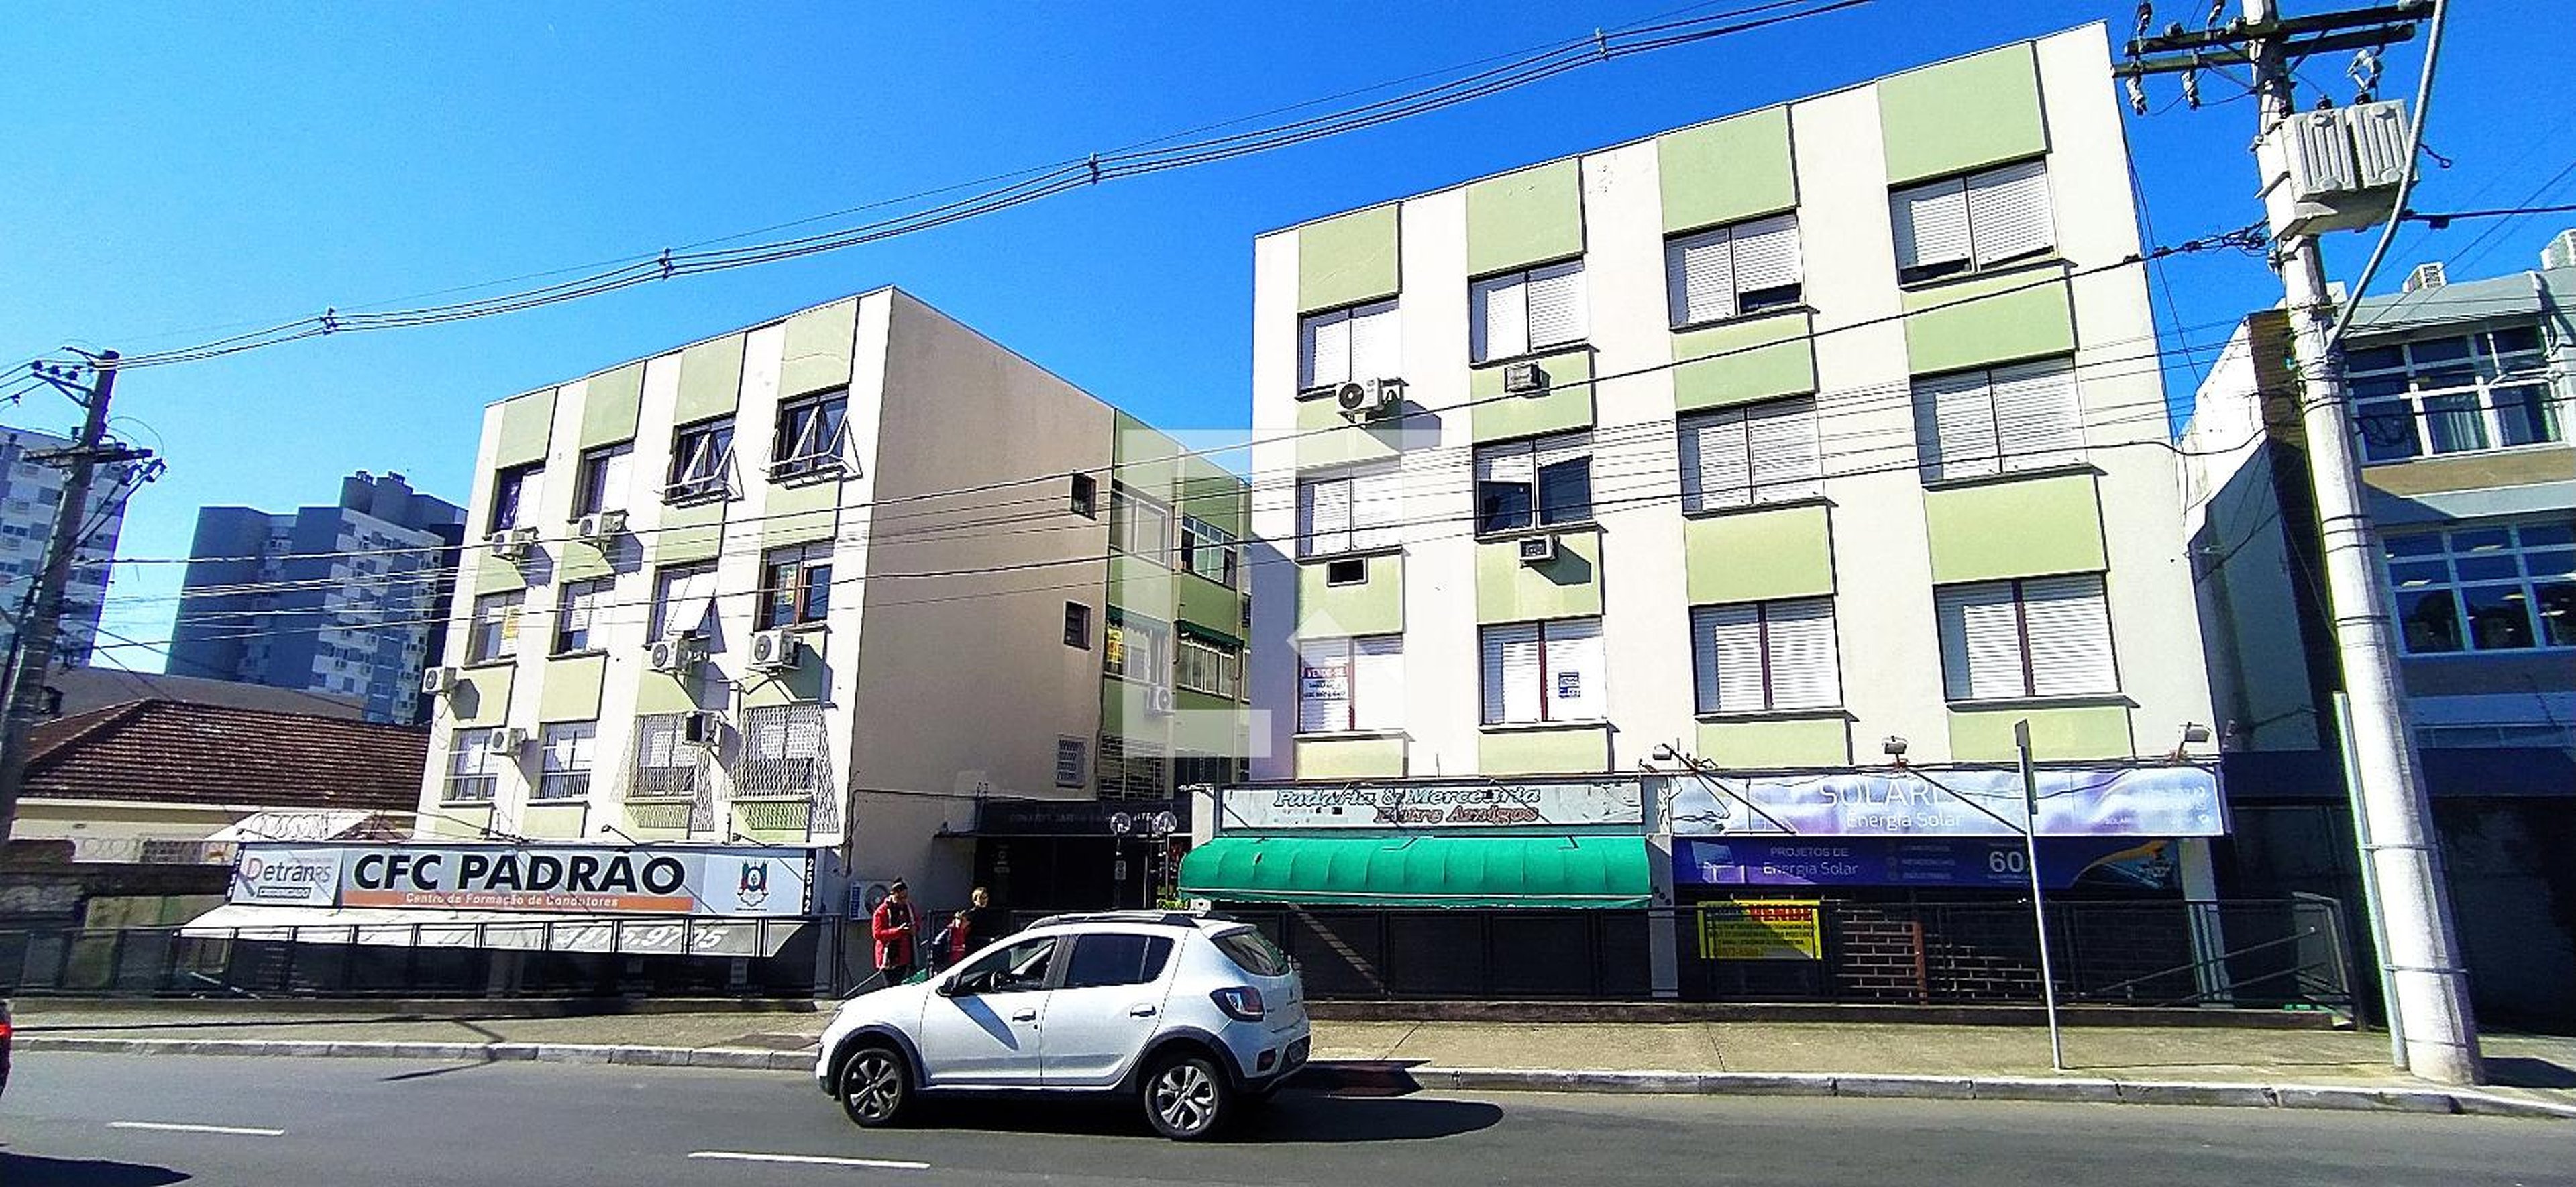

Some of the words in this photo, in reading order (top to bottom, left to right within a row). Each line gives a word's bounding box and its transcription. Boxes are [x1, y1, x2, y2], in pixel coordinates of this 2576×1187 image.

[1446, 805, 1540, 825] Amigos
[1847, 811, 1911, 831] Energia
[1917, 812, 1964, 828] Solar
[1770, 846, 1830, 858] PROJETOS
[1833, 847, 1849, 858] DE
[354, 854, 442, 891] CFC
[458, 848, 686, 895] PADRÃO
[1763, 862, 1817, 877] Energia
[1821, 862, 1859, 875] Solar
[803, 858, 814, 912] 2542
[405, 893, 445, 904] Centro
[447, 893, 462, 904] de
[466, 894, 524, 907] Formação
[528, 895, 542, 905] de
